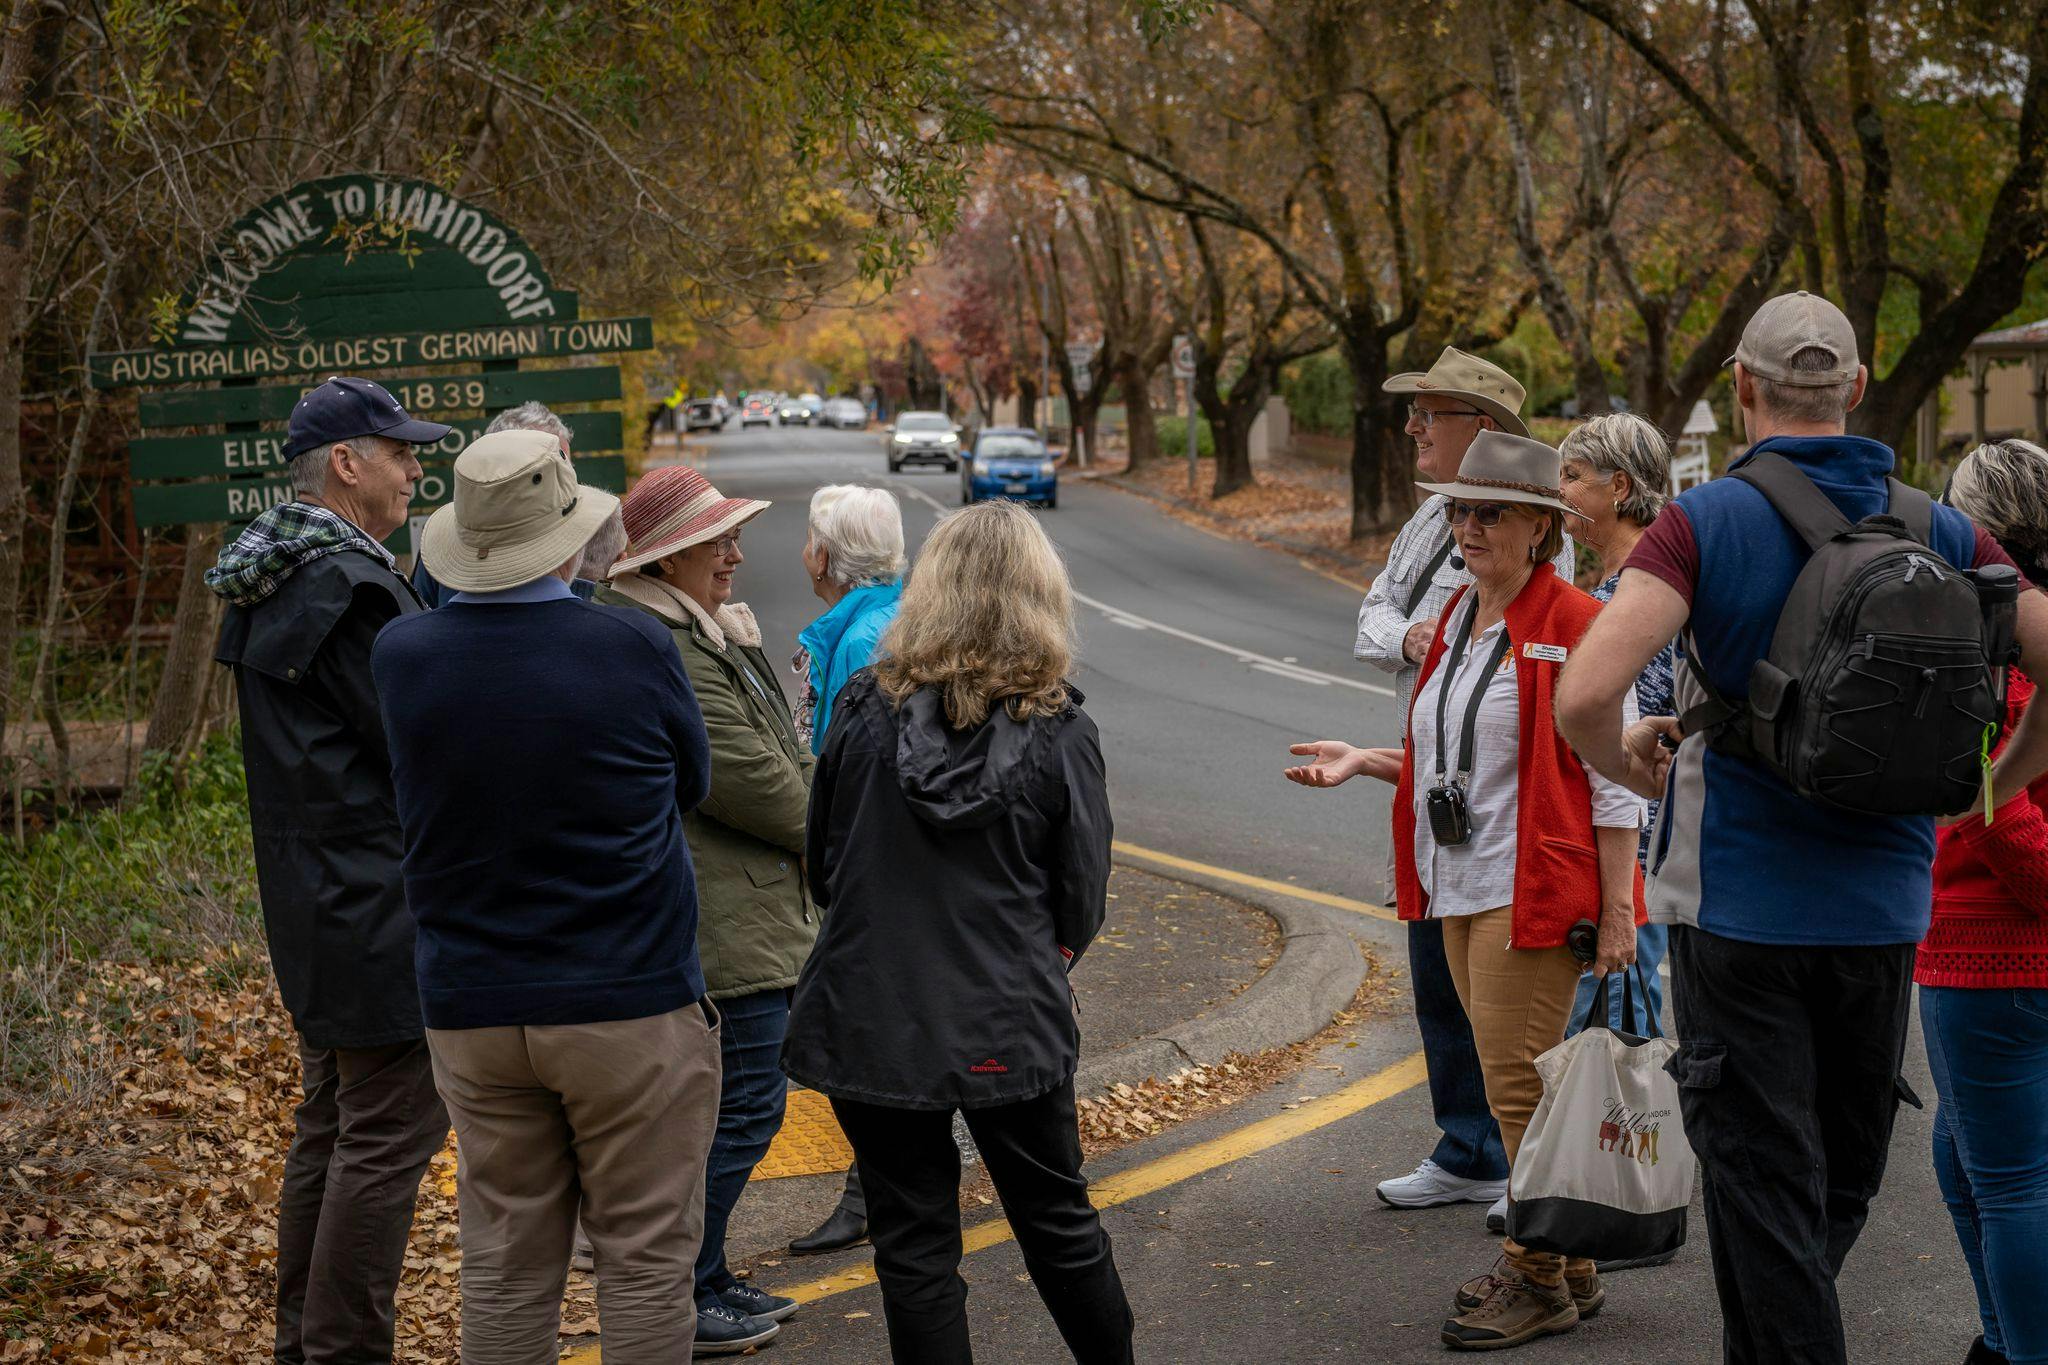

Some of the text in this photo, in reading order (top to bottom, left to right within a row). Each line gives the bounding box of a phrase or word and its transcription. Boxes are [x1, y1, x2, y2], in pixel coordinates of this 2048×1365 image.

[183, 182, 555, 342] WELCOME TO HAHNDORF
[112, 322, 632, 382] AUSTRALIAS OLDEST GERMAN TOWN
[400, 381, 485, 409] 1839
[224, 439, 289, 468] ELEV
[227, 485, 293, 514] RAIN
